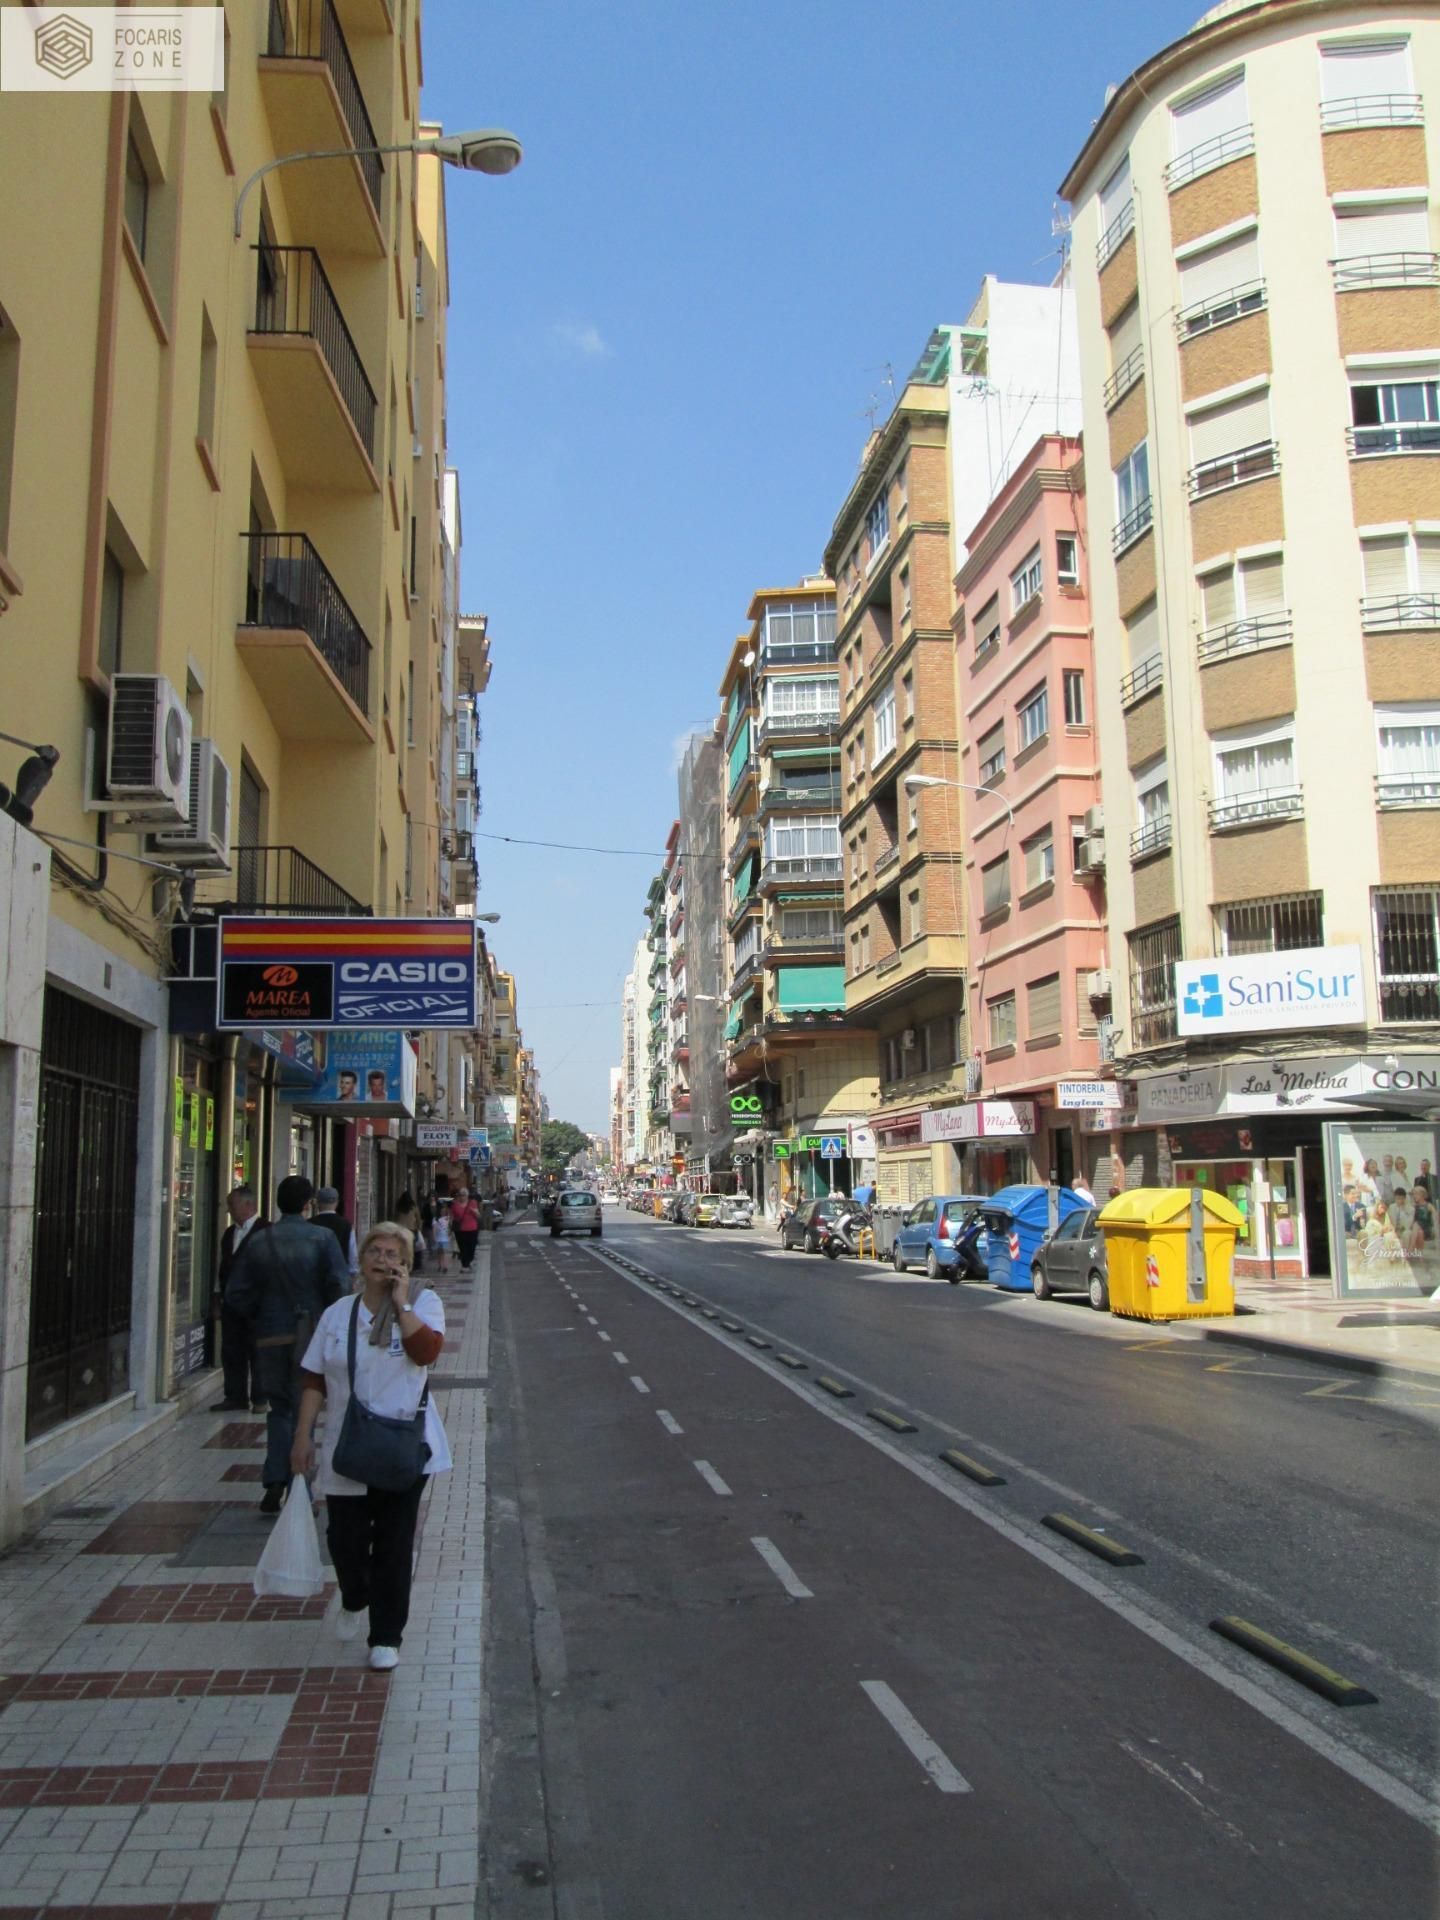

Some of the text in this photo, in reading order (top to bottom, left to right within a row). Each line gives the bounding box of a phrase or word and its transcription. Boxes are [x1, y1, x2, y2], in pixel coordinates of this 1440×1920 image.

[340, 962, 468, 983] CASIO
[1228, 969, 1356, 1008] SaniSur
[246, 991, 311, 1006] MAREA
[246, 1007, 311, 1018] Agente Oficial
[338, 994, 468, 1019] OFICIAL
[333, 1031, 397, 1044] TITANIC
[1058, 1083, 1105, 1094] TINTORERIA
[1241, 1071, 1349, 1094] Los Molina
[423, 1132, 451, 1140] ELOY
